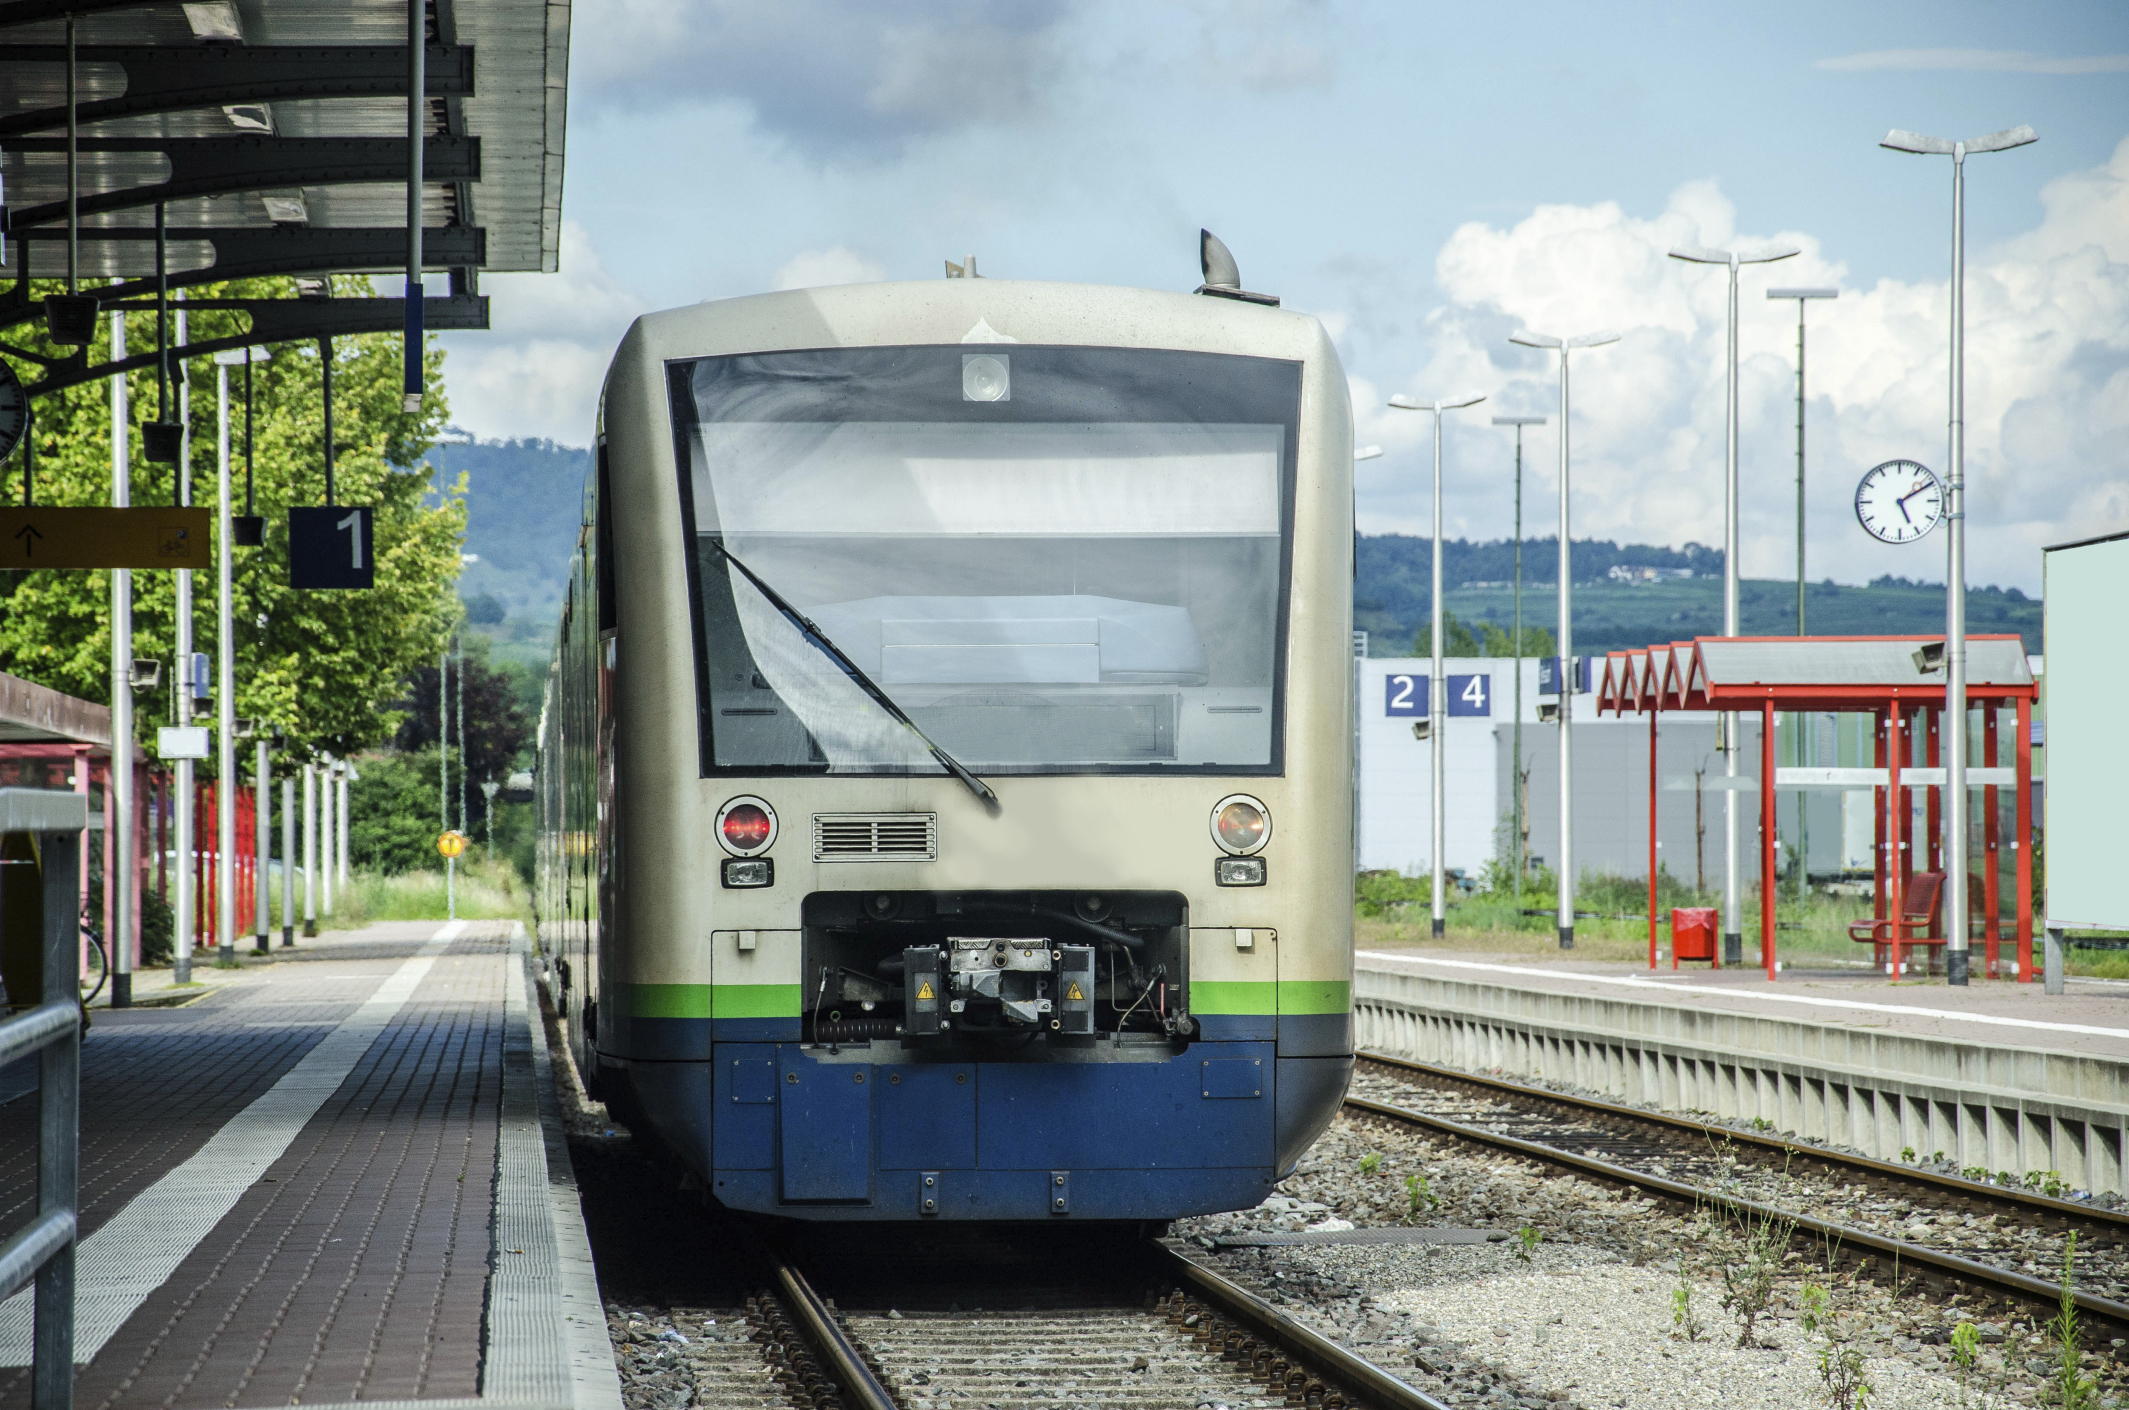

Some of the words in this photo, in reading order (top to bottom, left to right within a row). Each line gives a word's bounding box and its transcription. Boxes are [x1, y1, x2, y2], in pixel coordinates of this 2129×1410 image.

[337, 510, 363, 569] 1
[1391, 675, 1414, 708] 2
[1462, 675, 1486, 708] 4
